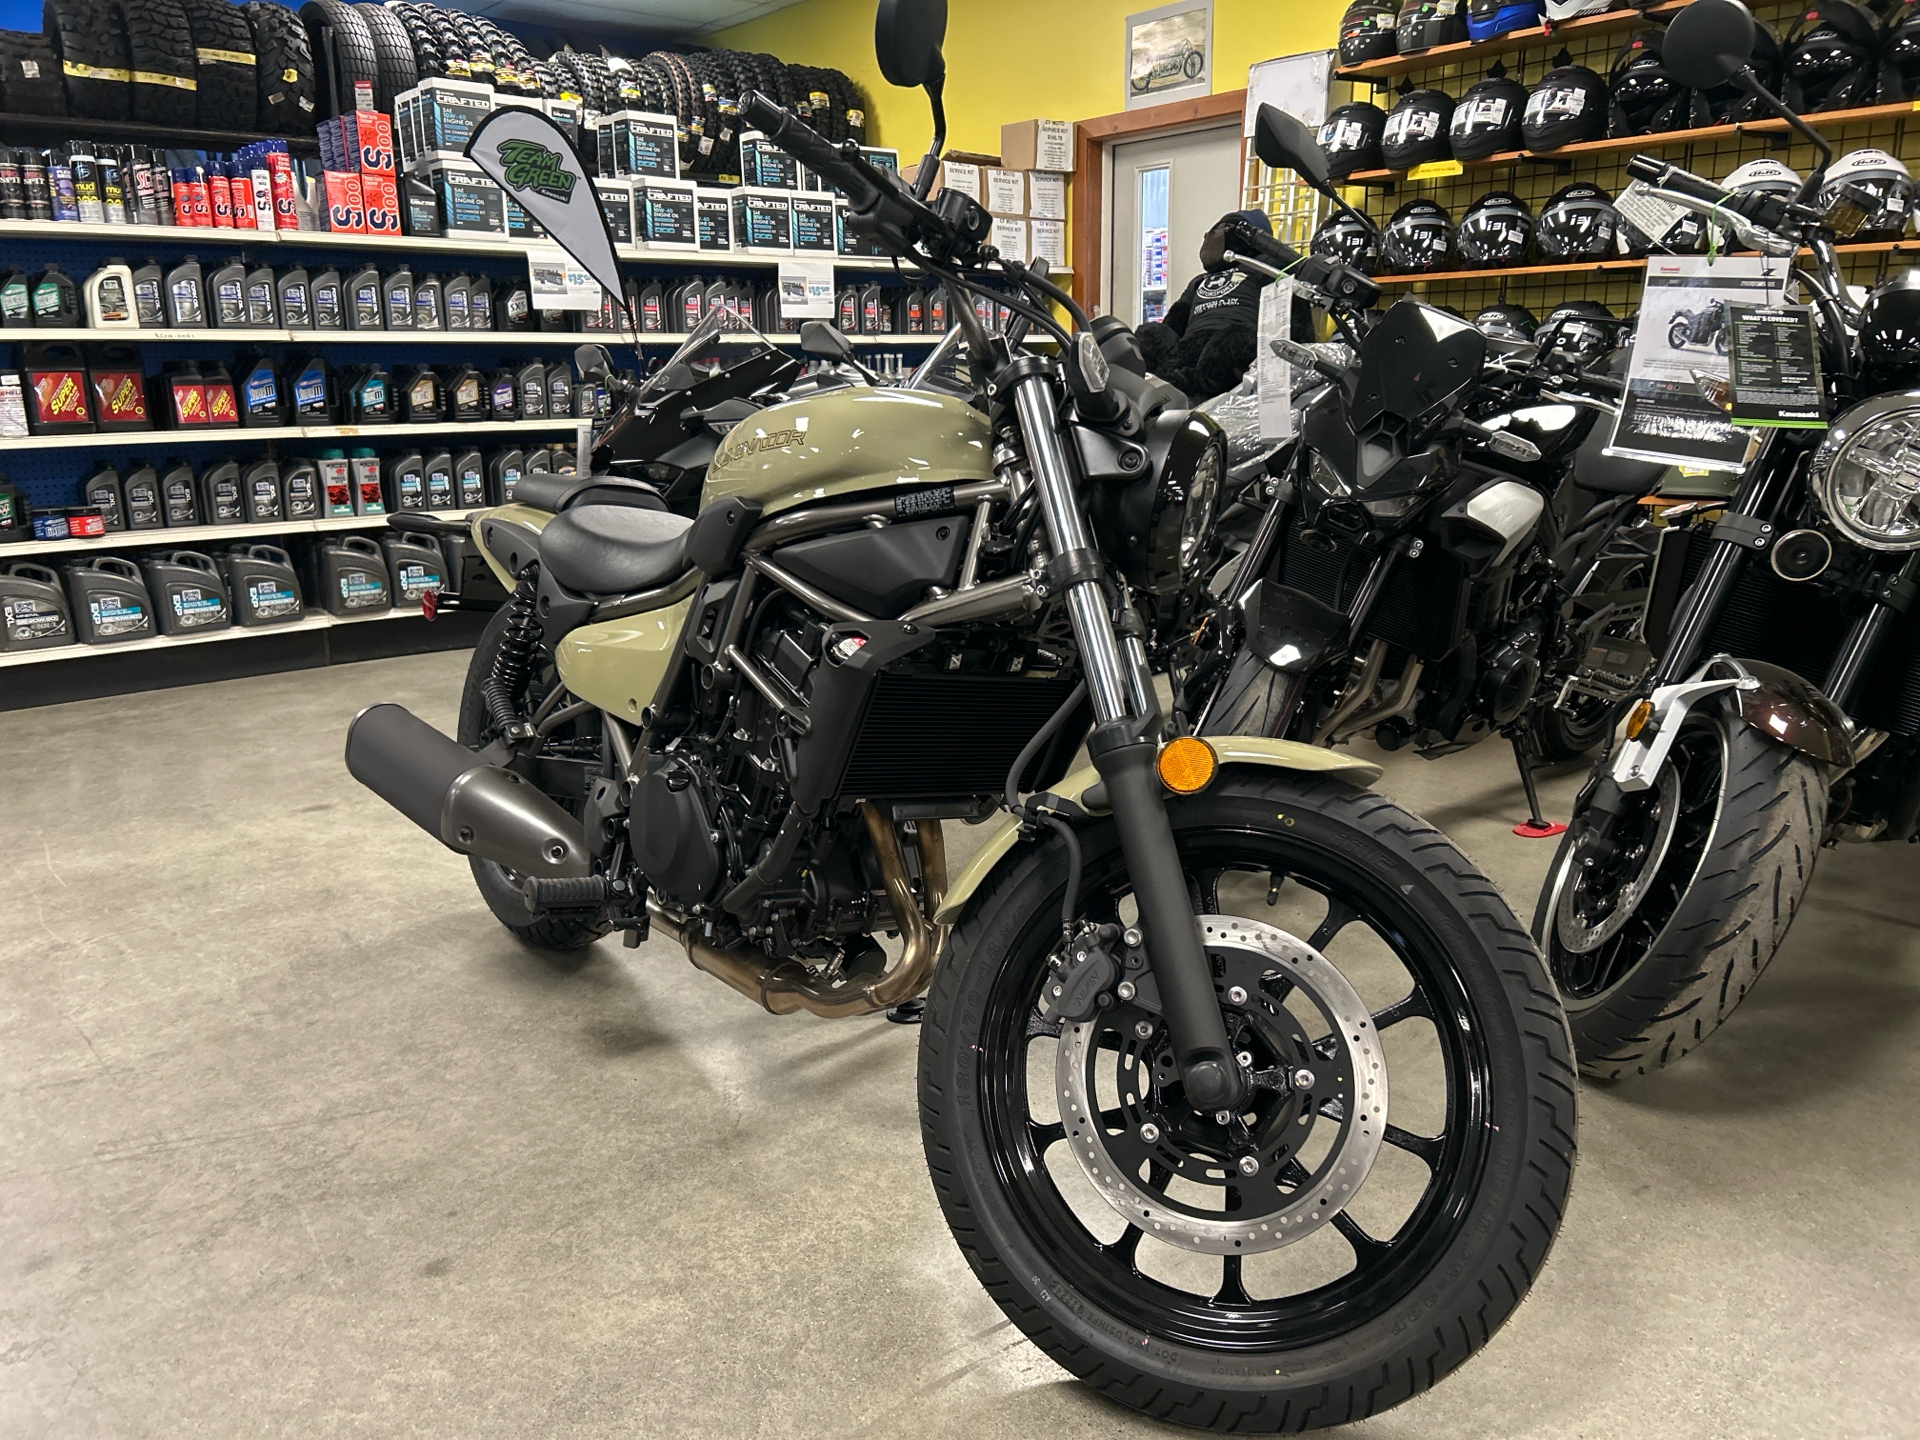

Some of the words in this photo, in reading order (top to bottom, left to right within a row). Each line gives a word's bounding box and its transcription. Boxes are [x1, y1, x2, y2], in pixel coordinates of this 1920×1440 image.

[436, 94, 490, 108] CRAFTED
[630, 126, 673, 137] CRAFTED
[1043, 126, 1060, 134] SERVICE
[362, 120, 394, 170] S100
[757, 144, 785, 152] CRAF
[500, 141, 560, 170] TEAM
[136, 171, 152, 189] SC
[508, 164, 573, 190] GREEN
[76, 182, 94, 190] mud
[331, 179, 364, 229] S100
[542, 189, 568, 202] Kawasaki
[599, 193, 628, 202] AFTED
[648, 192, 692, 201] CRAFTED
[368, 182, 400, 232] S100
[698, 202, 727, 211] AFTED
[748, 201, 788, 209] CRAFTED
[794, 203, 831, 212] CRAFTED
[567, 273, 584, 285] $15
[1479, 312, 1506, 321] HJC
[50, 377, 74, 416] SUPER
[112, 378, 133, 414] SUPER
[182, 390, 199, 417] SUPER
[212, 390, 228, 417] SUPER
[1779, 411, 1819, 419] Kawasaki
[340, 578, 348, 598] EXP
[173, 594, 182, 616] EXP
[250, 587, 259, 608] EXP
[4, 607, 14, 628] EXL
[91, 603, 101, 624] EXP
[956, 942, 1001, 1107] 130/70-18
[1154, 1346, 1179, 1363] DOT
[1210, 1366, 1262, 1376] ROTATION
